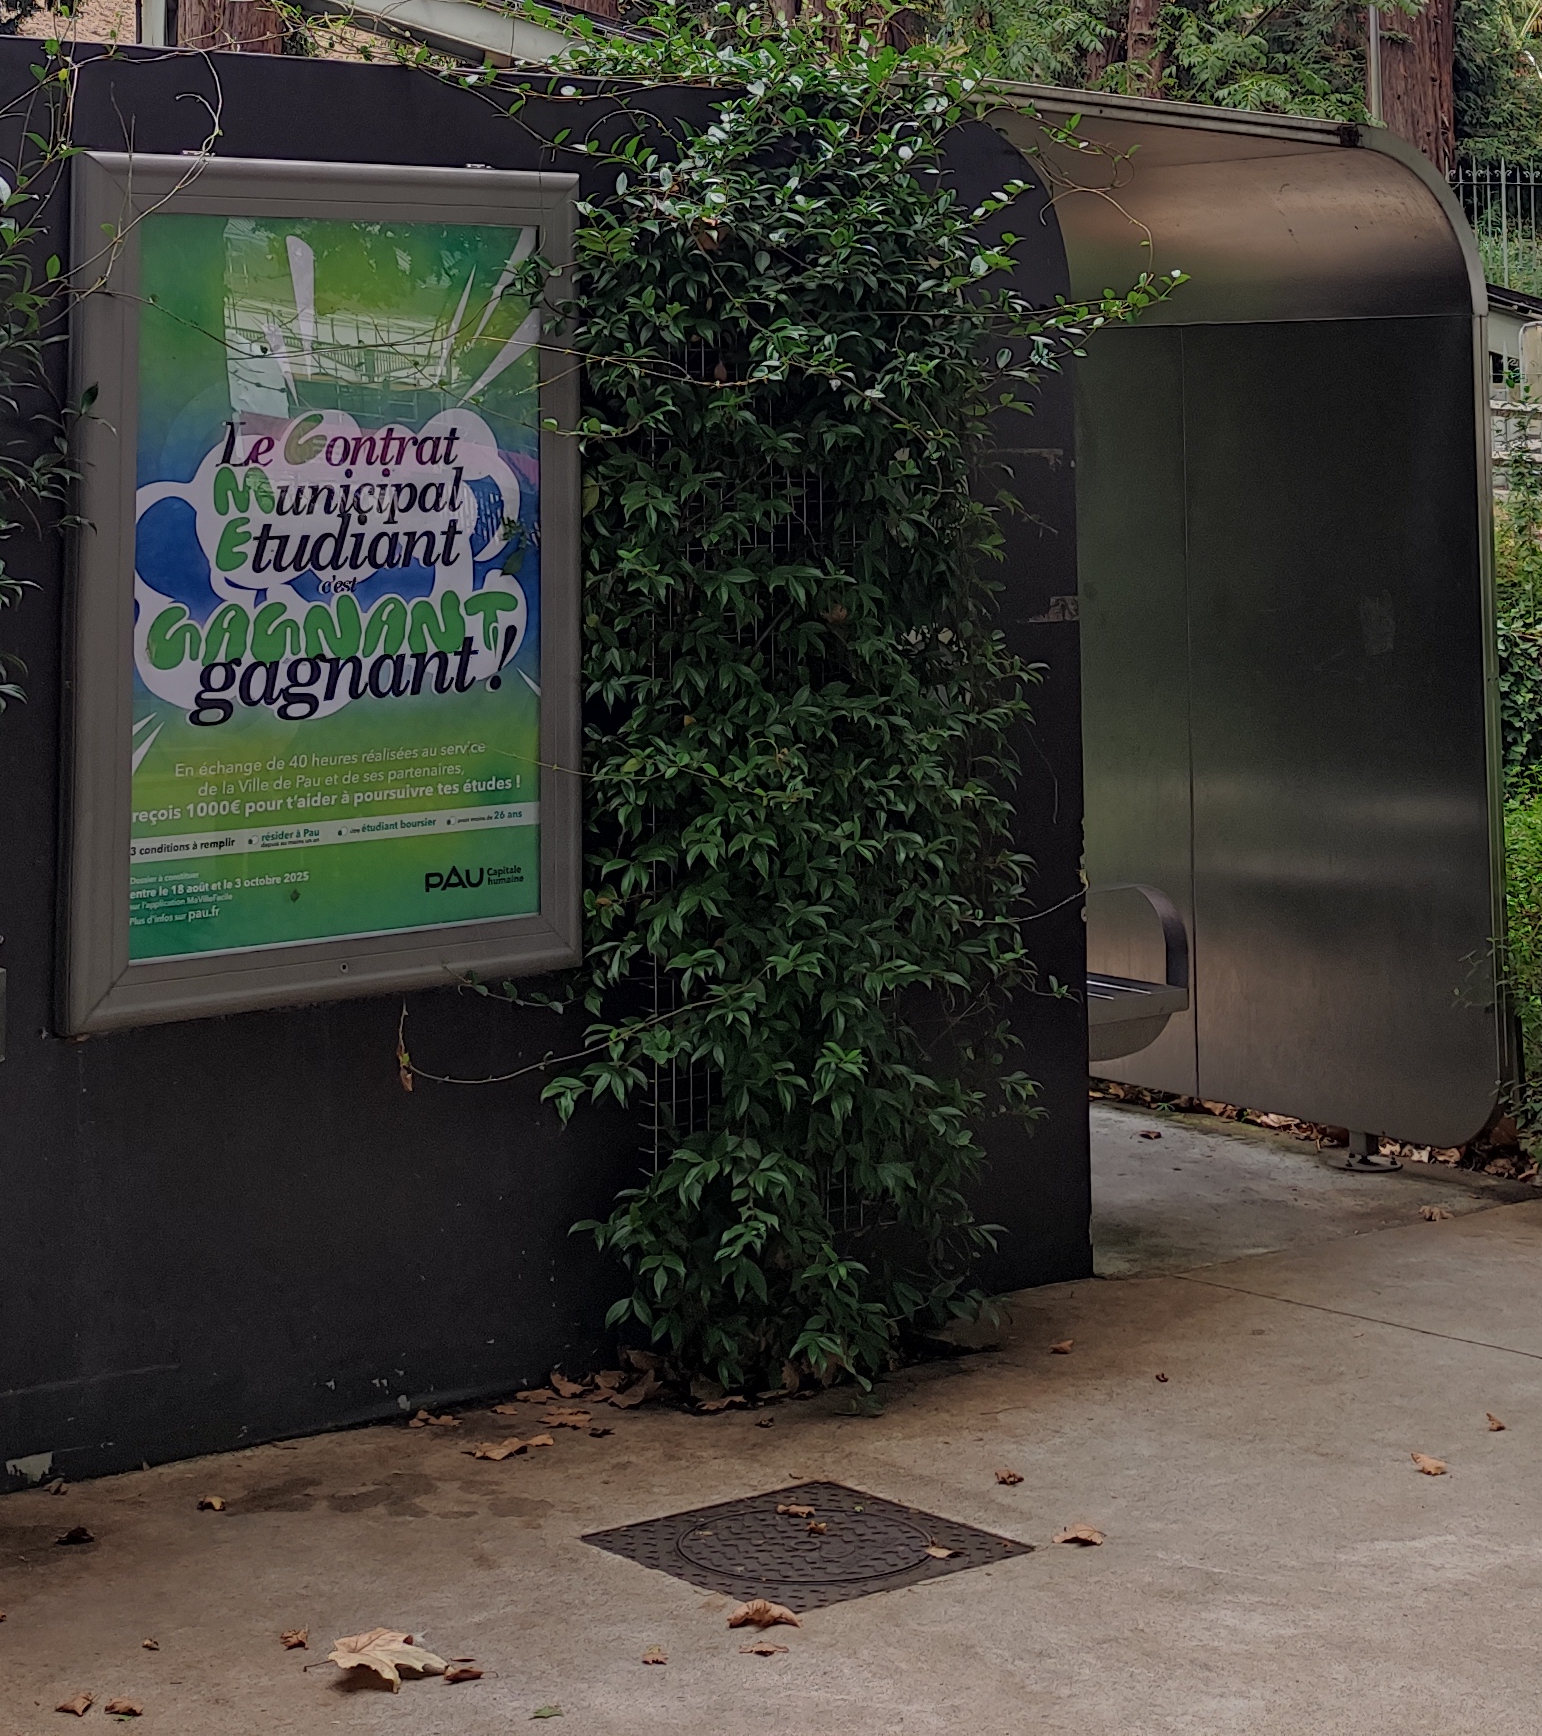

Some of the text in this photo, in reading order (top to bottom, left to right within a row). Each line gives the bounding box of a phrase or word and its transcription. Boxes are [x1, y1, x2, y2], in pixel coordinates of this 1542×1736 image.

[216, 413, 460, 467] Le Contrat
[213, 466, 464, 525] Municipal
[215, 514, 463, 574] Etudiant
[321, 574, 357, 594] c'est
[148, 590, 519, 671] GAGNANT
[188, 636, 479, 727] gagnant
[175, 763, 194, 777] En
[199, 760, 262, 776] échange
[266, 756, 285, 770] de
[289, 754, 308, 768] 40
[312, 753, 358, 767] heures
[361, 745, 419, 763] réalisées
[421, 746, 437, 758] au
[198, 763, 465, 796] de la Ville de Pau et de ses partenaires,
[132, 805, 181, 826] reçois
[186, 799, 241, 819] 1000€
[245, 799, 283, 818] pour
[286, 791, 337, 809] t'aider
[341, 790, 350, 804] à
[354, 784, 434, 807] poursuivre
[438, 782, 459, 796] tes
[463, 775, 512, 793] études
[494, 810, 505, 820] 26
[507, 810, 523, 819] ans
[262, 828, 320, 842] résider à Pau
[362, 821, 399, 833] étudiant
[400, 817, 437, 829] boursier
[130, 837, 235, 856] 3 conditions à remplir
[129, 870, 309, 900] entre le 18 août et le 3 octobre 2025
[425, 864, 522, 892] PAU Capitale
[487, 874, 524, 886] humaine
[188, 905, 220, 923] pau.fr
